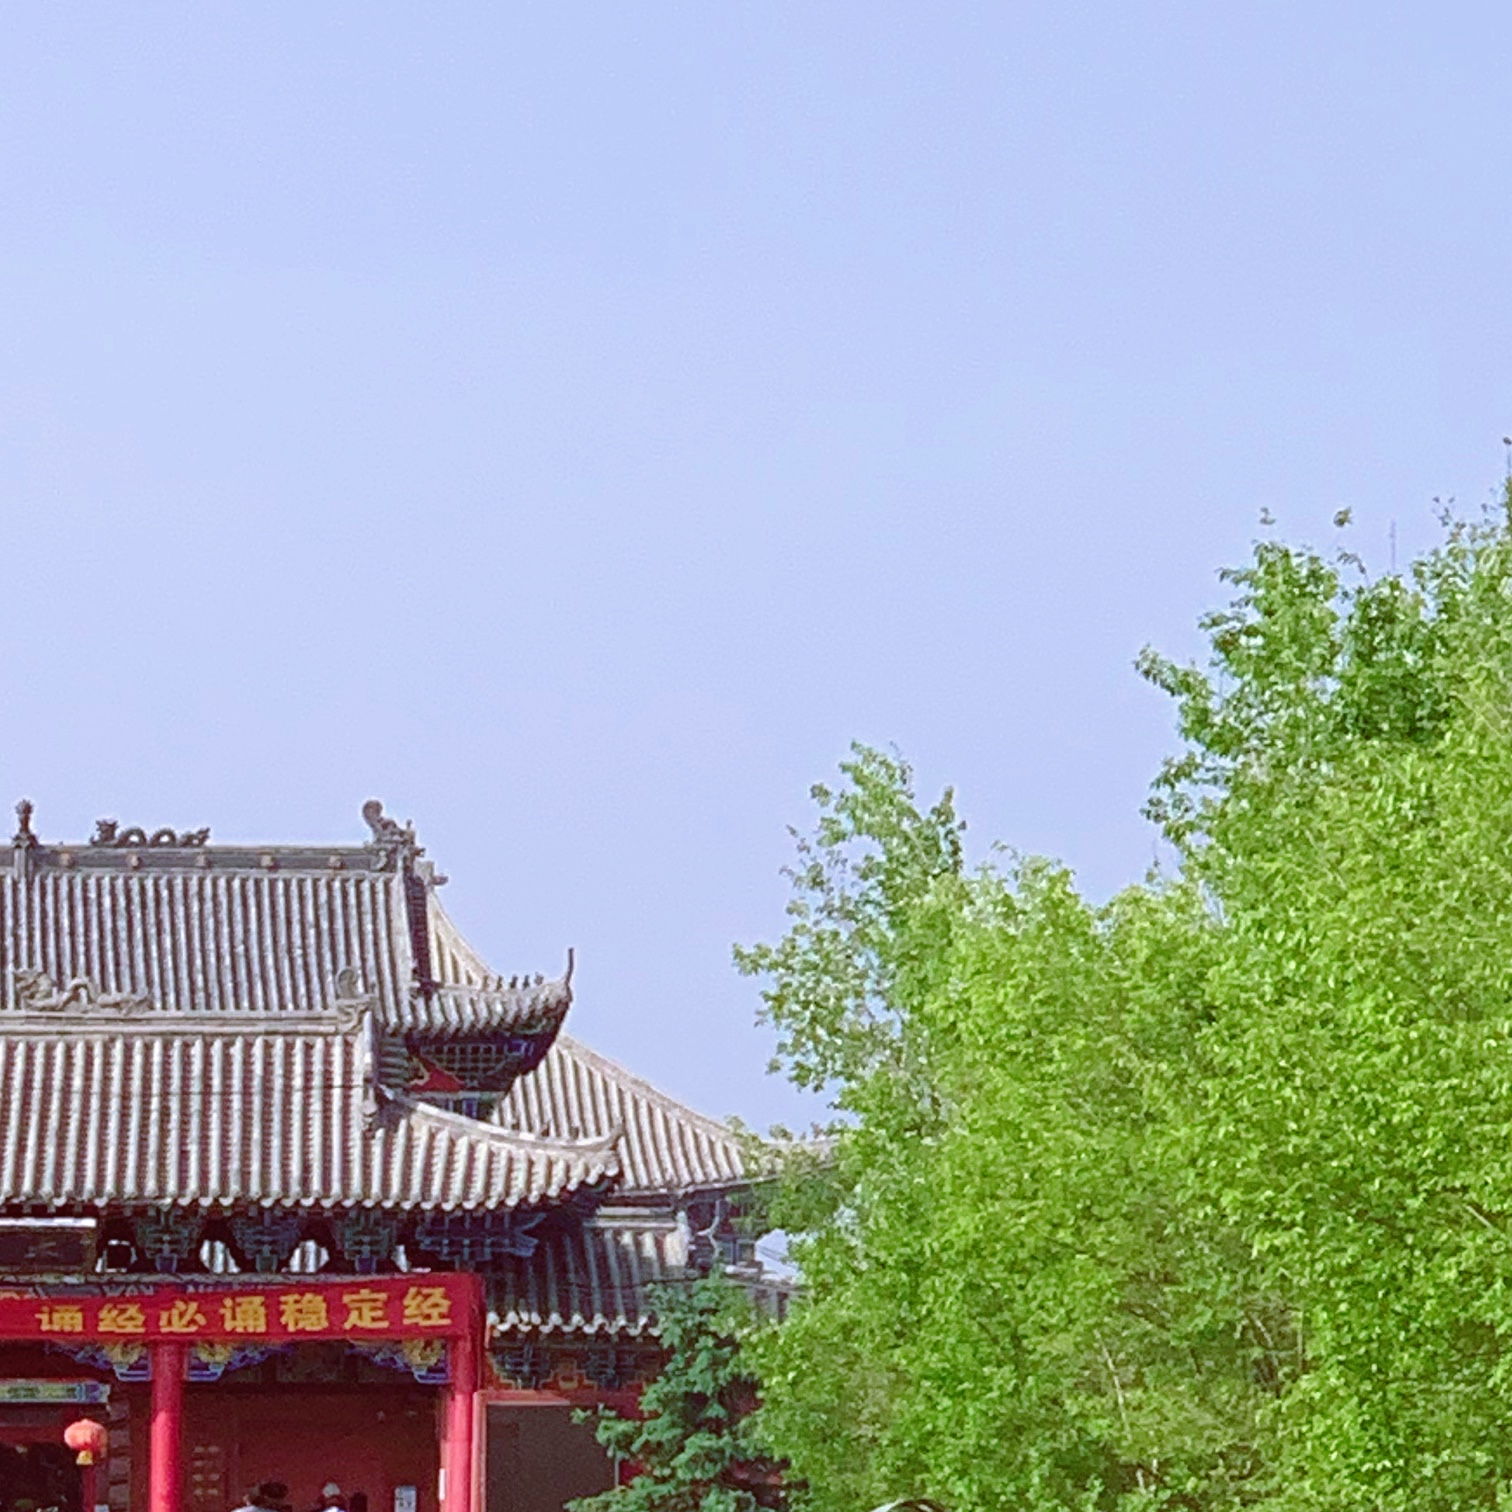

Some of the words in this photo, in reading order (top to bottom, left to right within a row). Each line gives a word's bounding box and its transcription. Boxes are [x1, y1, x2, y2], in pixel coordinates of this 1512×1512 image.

[35, 1286, 453, 1333] 诵经必诵稳定经
